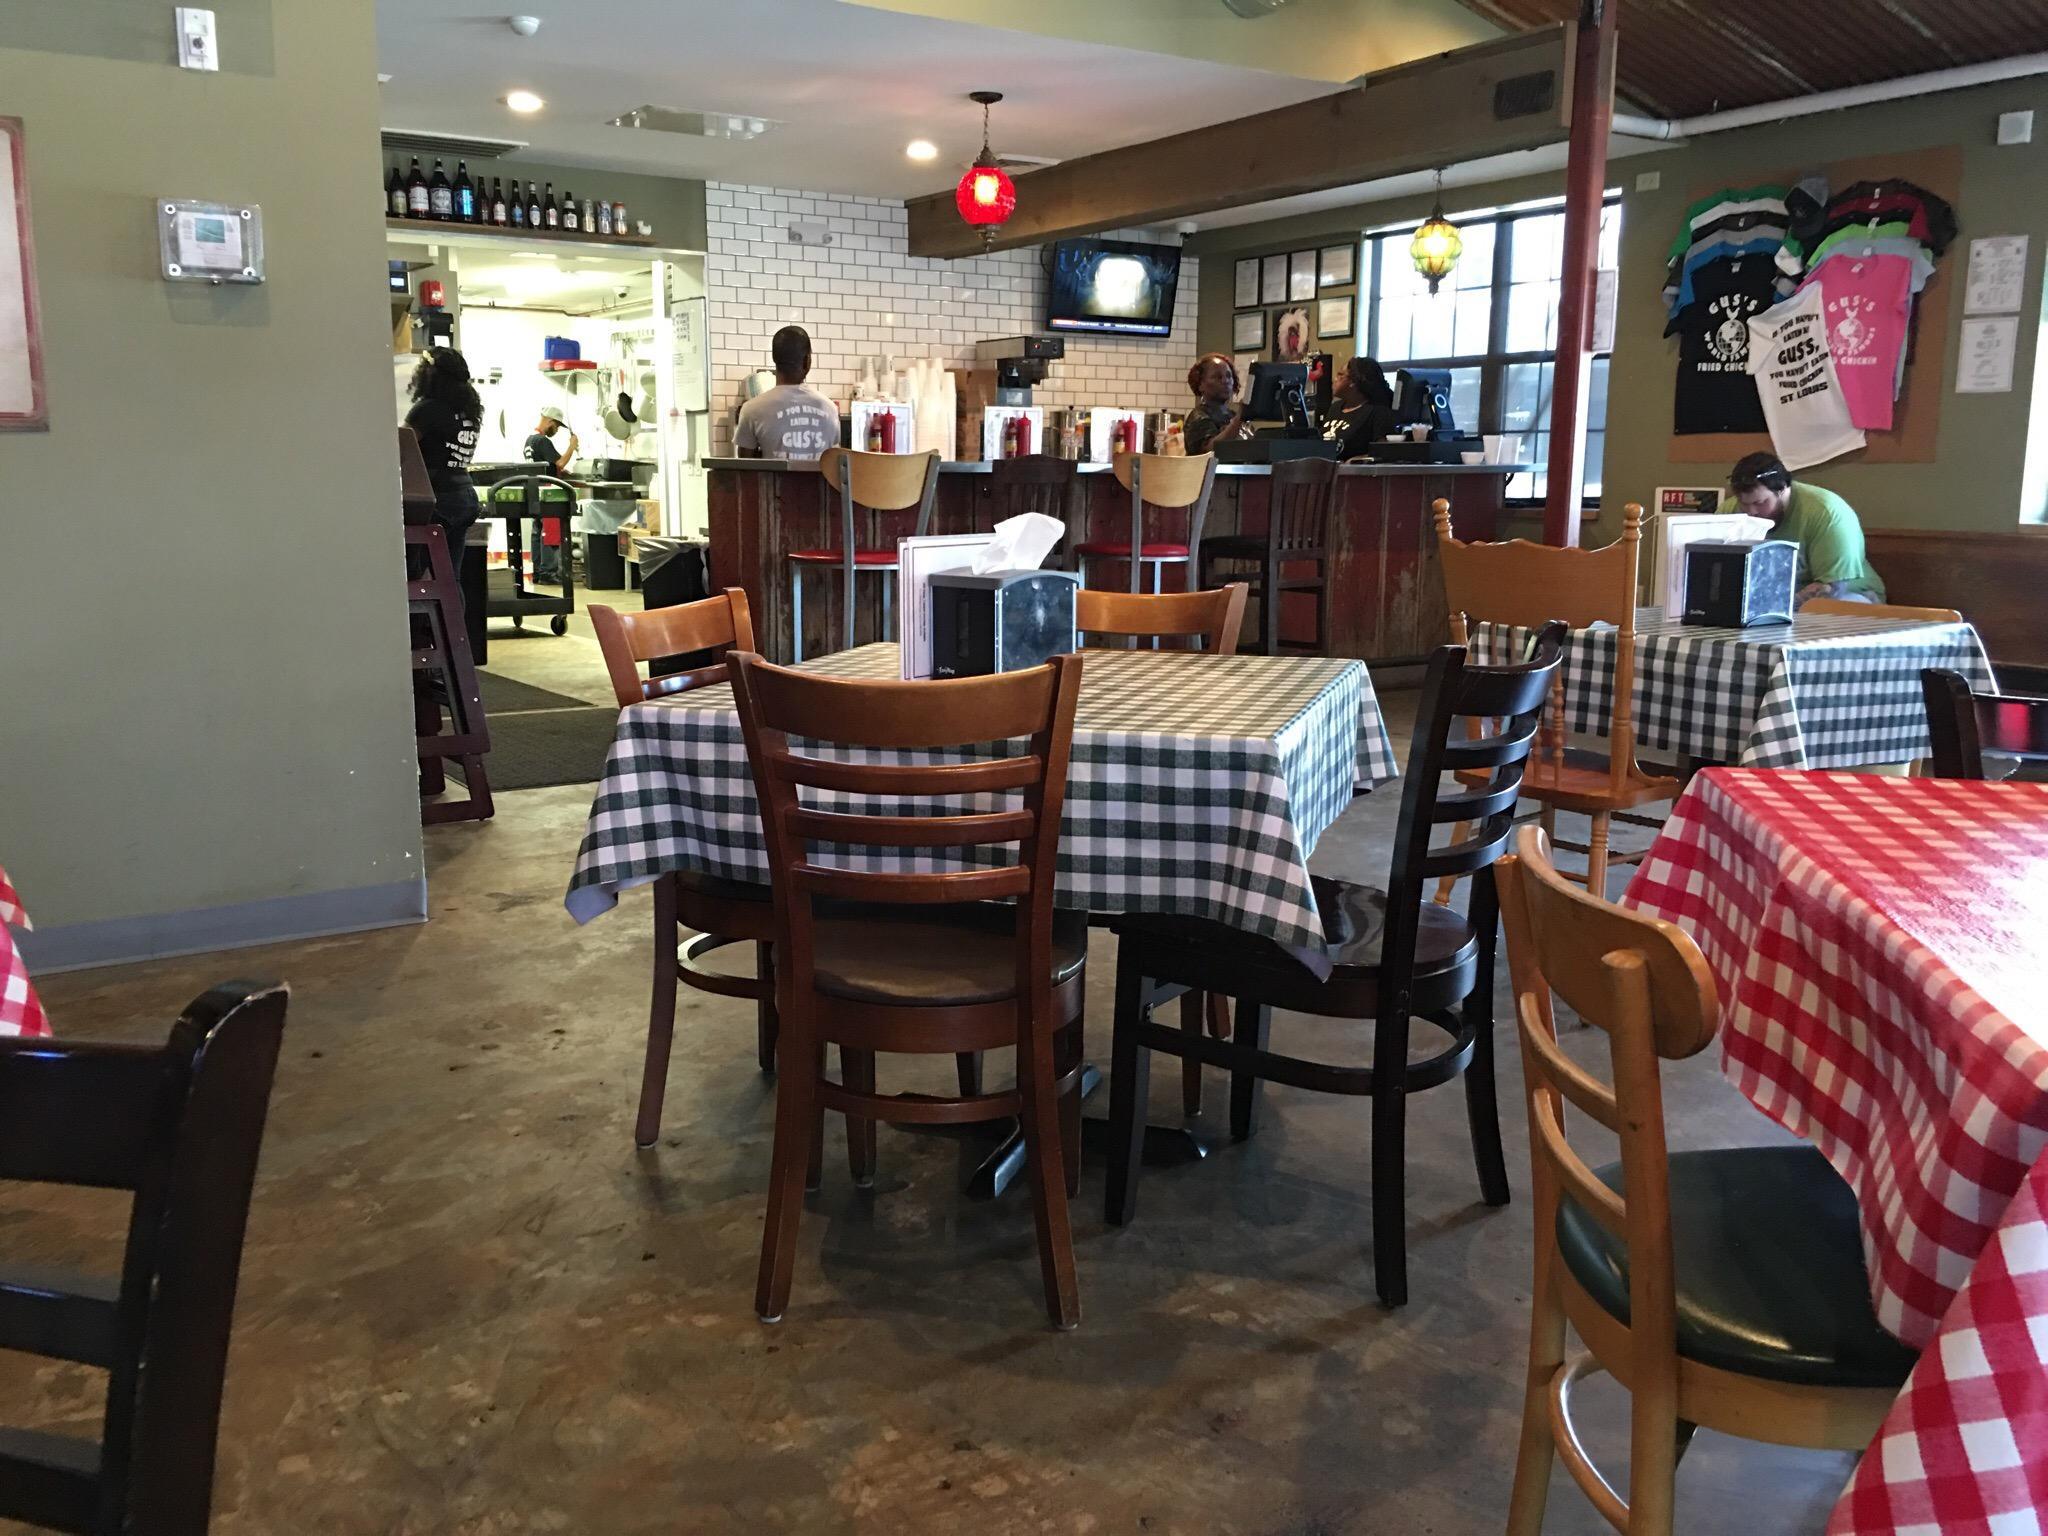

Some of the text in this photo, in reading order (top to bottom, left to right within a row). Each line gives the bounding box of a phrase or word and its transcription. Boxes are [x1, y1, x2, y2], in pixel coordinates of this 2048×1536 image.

[1708, 293, 1758, 315] GUS'S
[1828, 294, 1876, 313] GUS'S
[1697, 362, 1722, 372] FRIED
[1780, 381, 1828, 405] ST LOUIS
[1663, 492, 1684, 503] RFT
